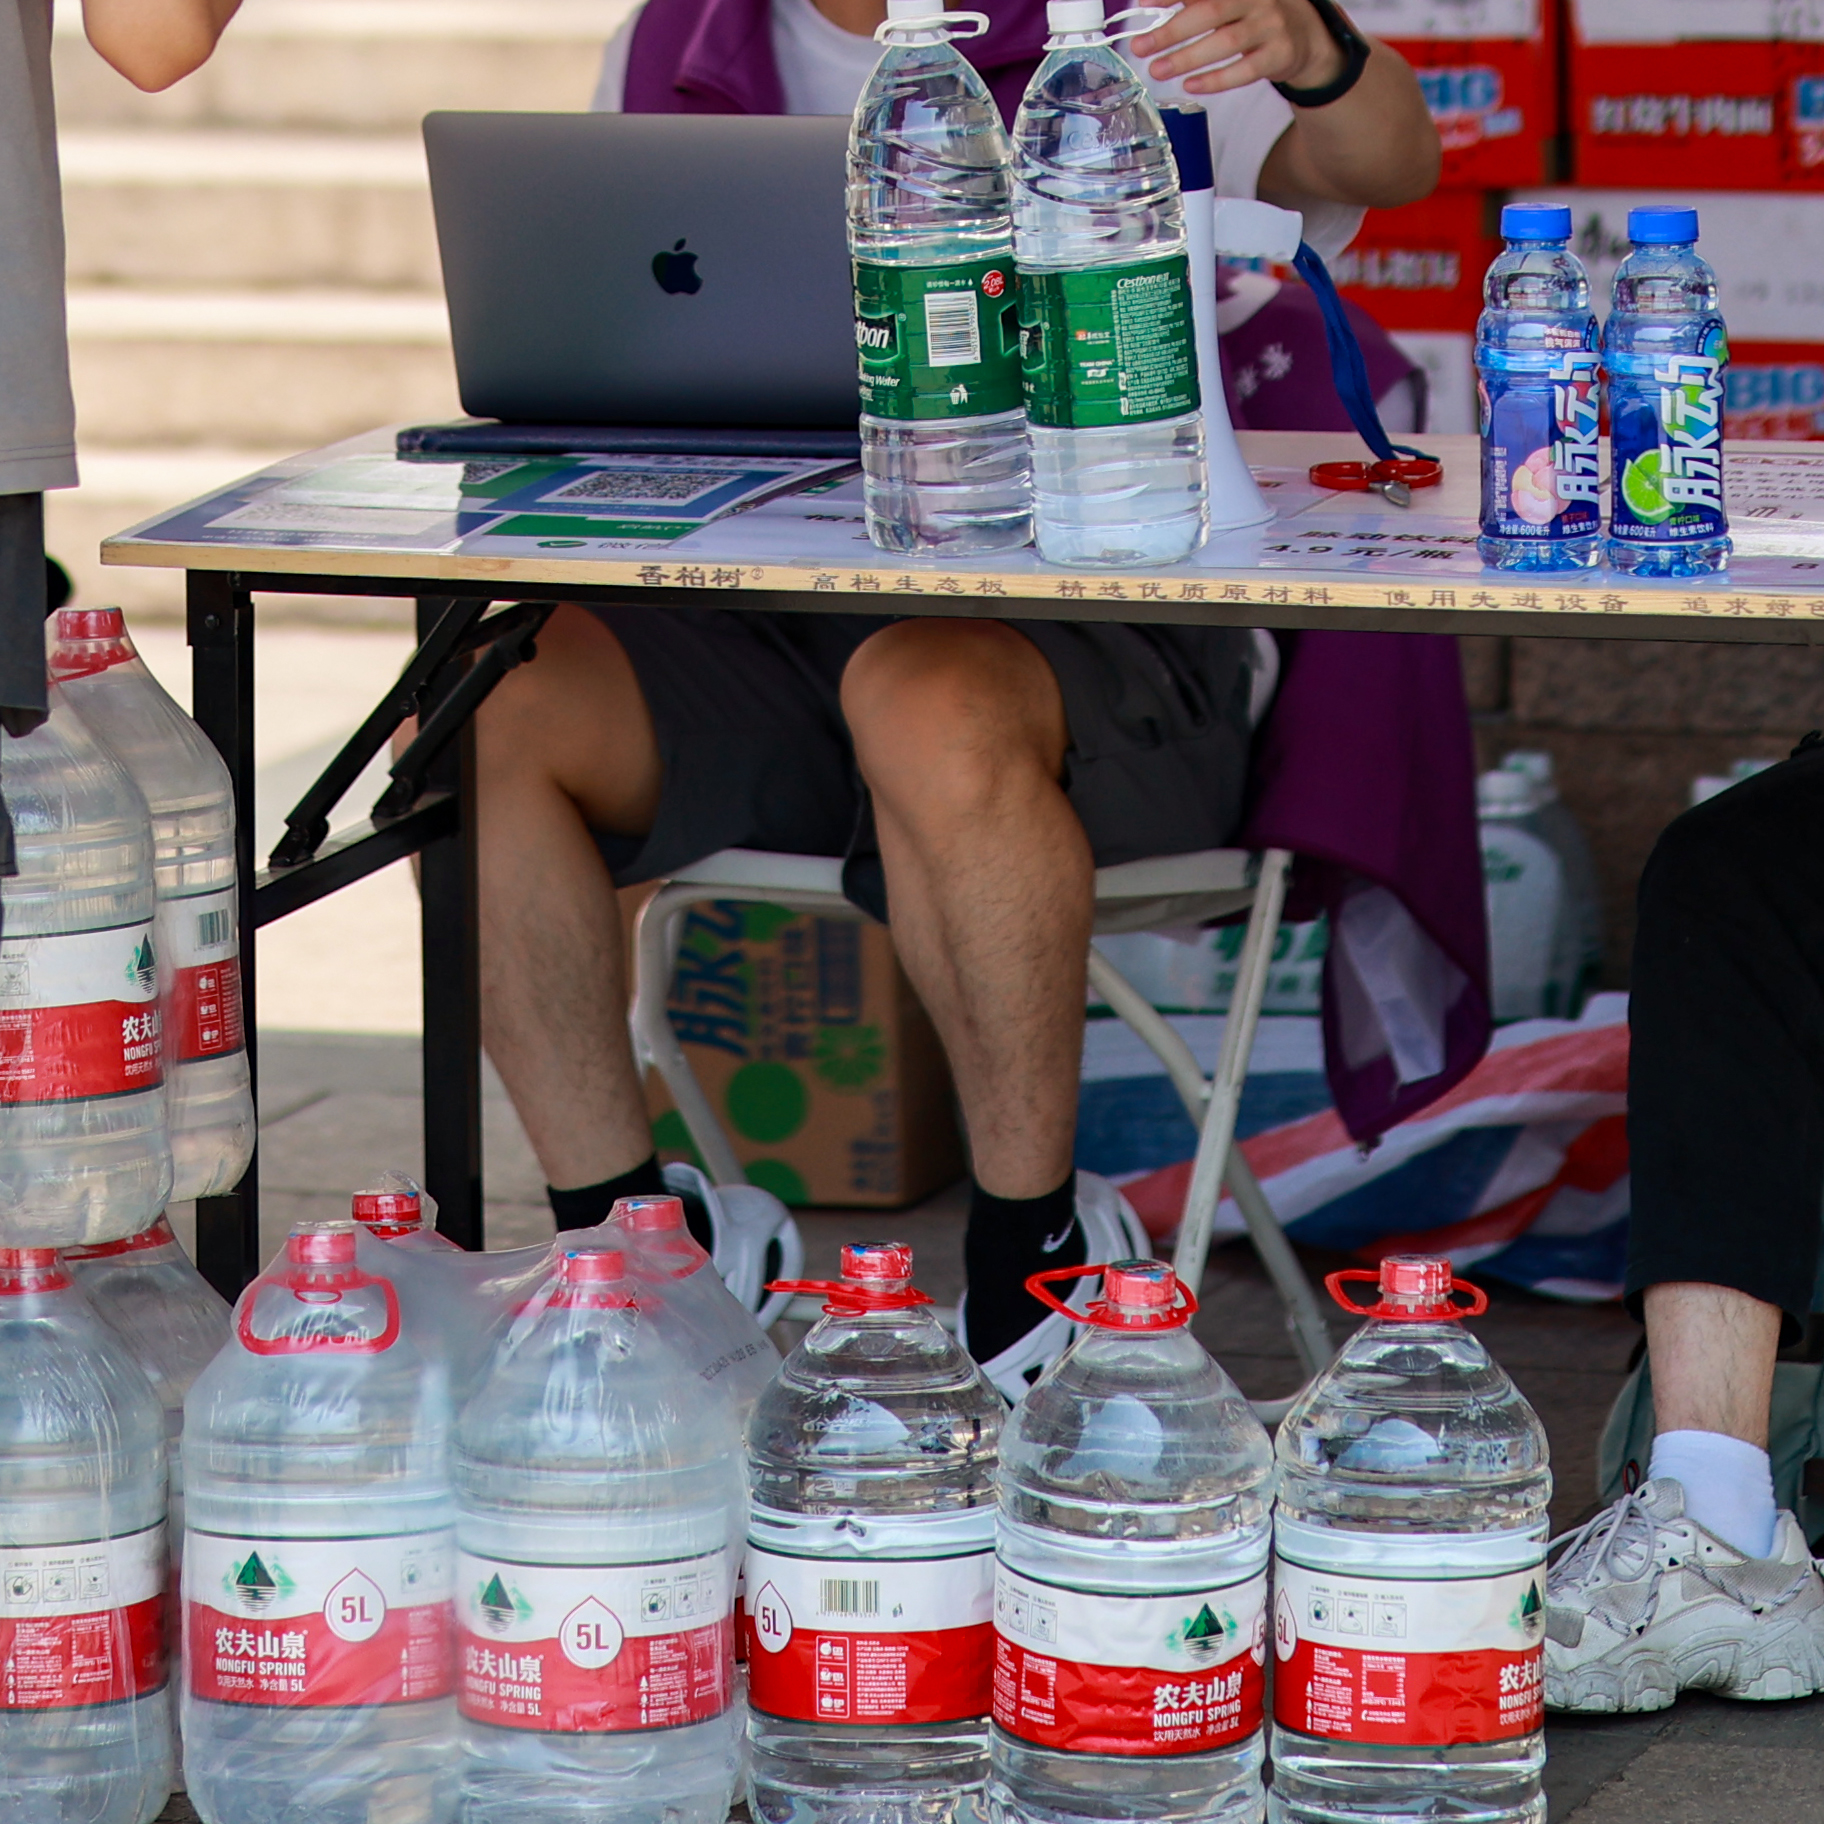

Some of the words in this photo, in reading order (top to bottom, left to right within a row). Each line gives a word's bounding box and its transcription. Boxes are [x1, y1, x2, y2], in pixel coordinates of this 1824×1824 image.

[876, 375, 900, 388] Water
[1654, 355, 1724, 512] 脉动
[1263, 544, 1333, 554] 4.9
[1341, 546, 1461, 560] 元/瓶
[1792, 562, 1819, 570] 8
[635, 565, 747, 589] 香柏树
[811, 572, 1008, 597] 高档生态板
[1054, 578, 1334, 605] 精选优质原材料
[1382, 588, 1629, 613] 使用先进设备
[122, 1010, 162, 1045] 农夫山
[123, 1045, 154, 1062] NONGFU
[341, 1596, 373, 1624] 5L
[762, 1606, 782, 1637] 5L
[1277, 1613, 1290, 1646] 5L
[215, 1627, 306, 1660] 农夫山泉
[576, 1623, 610, 1651] 5L
[215, 1657, 255, 1674] NONGFU
[259, 1659, 306, 1677] SPRING
[1499, 1654, 1545, 1693] 农夫山
[290, 1679, 306, 1693] 5L
[499, 1685, 542, 1701] SPRING
[1153, 1669, 1243, 1711] 农夫山泉
[527, 1701, 542, 1717] 5L
[1499, 1688, 1533, 1710] NONGFU
[1153, 1709, 1204, 1728] NONGFU
[1153, 1726, 1201, 1743] 饮用天然水
